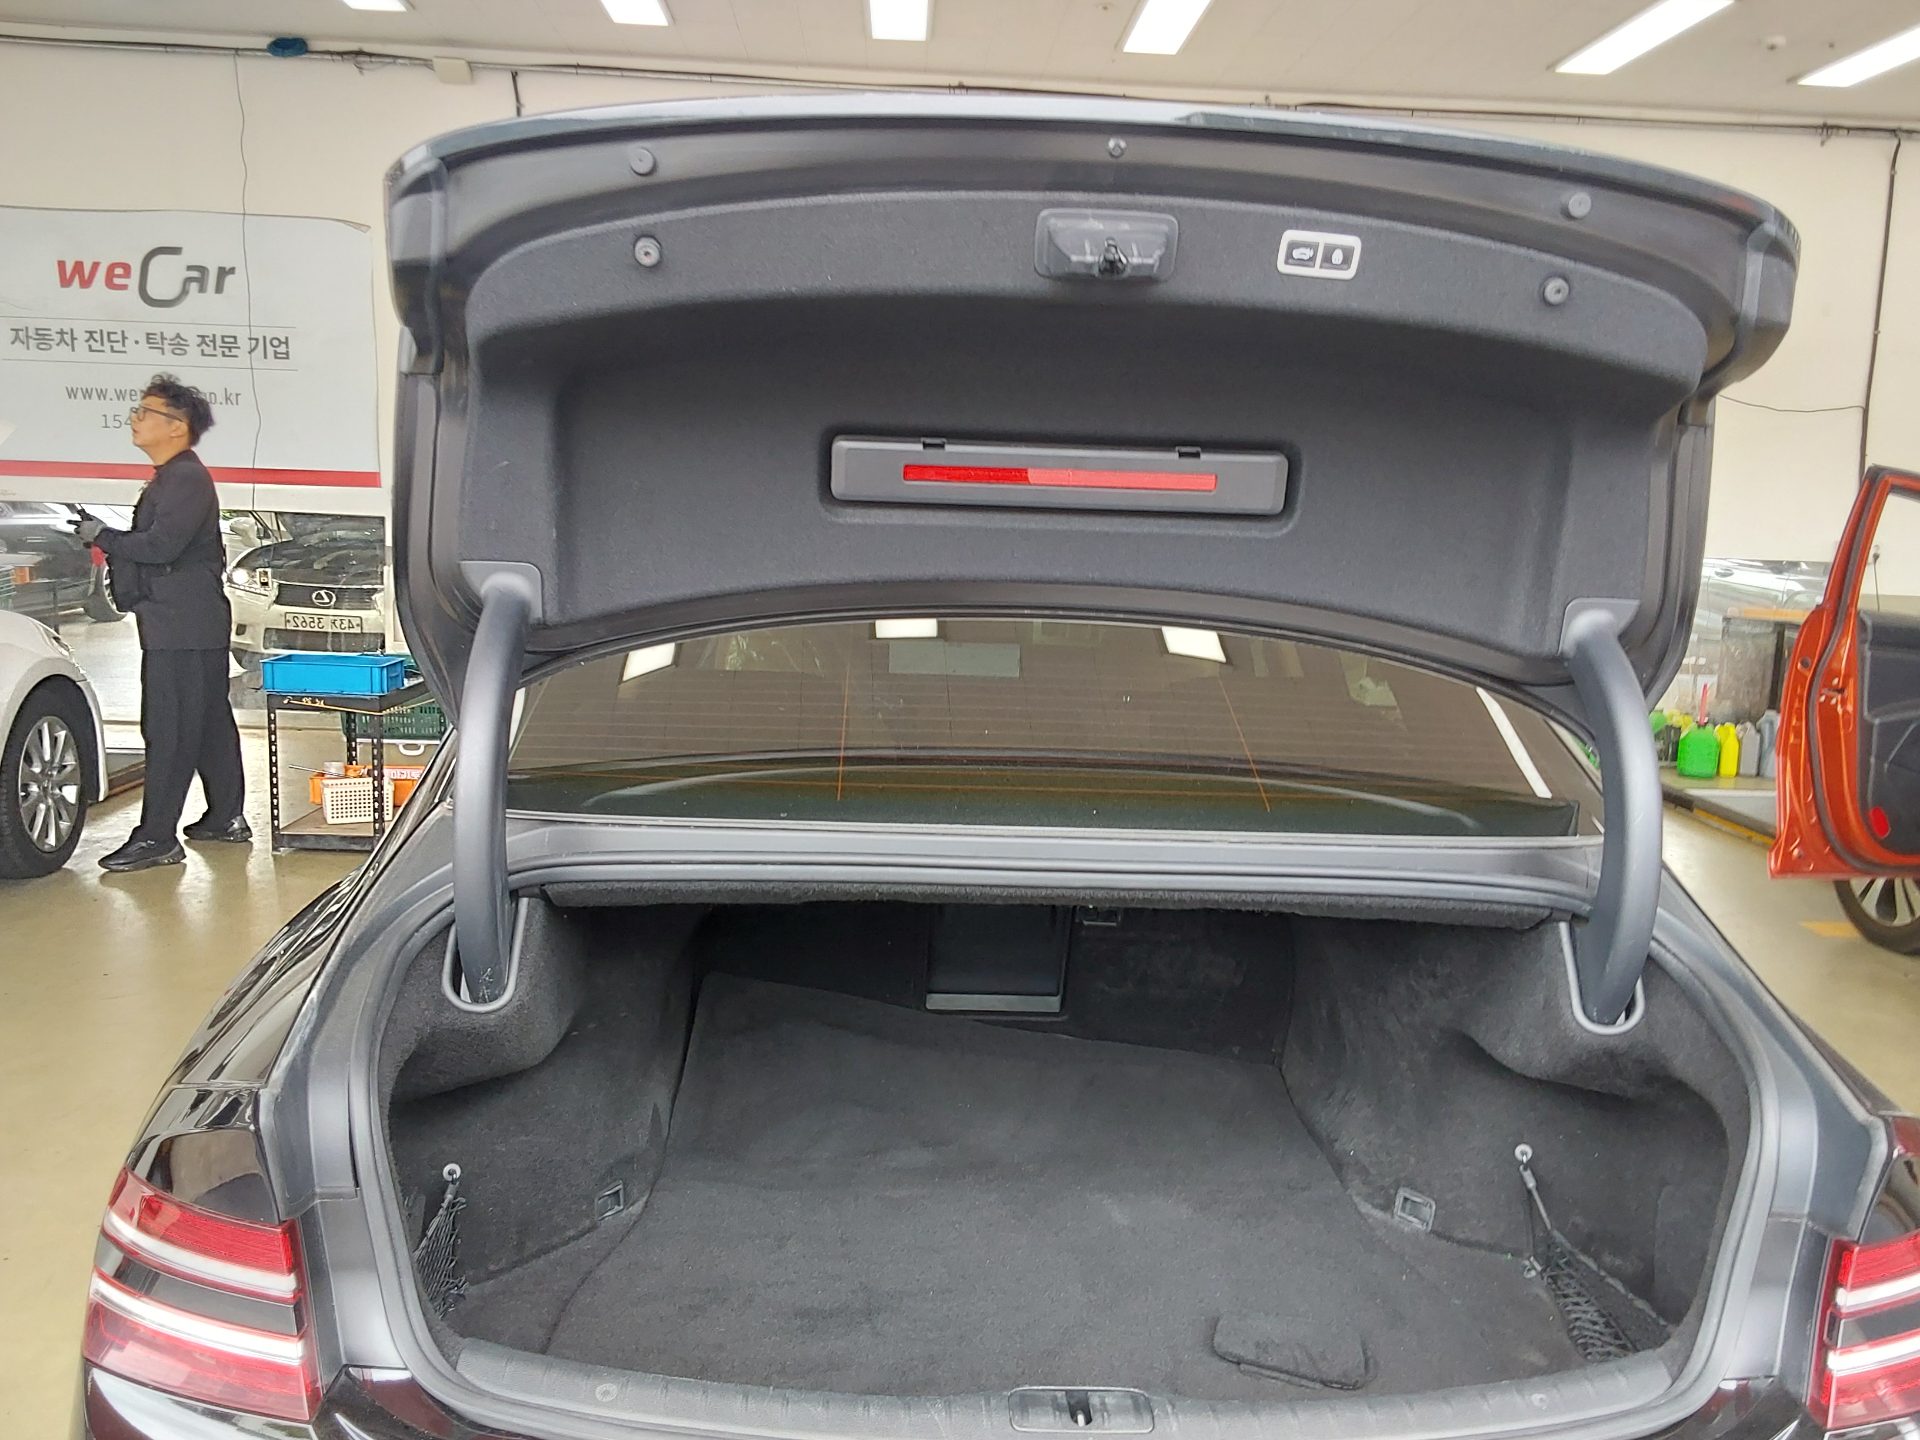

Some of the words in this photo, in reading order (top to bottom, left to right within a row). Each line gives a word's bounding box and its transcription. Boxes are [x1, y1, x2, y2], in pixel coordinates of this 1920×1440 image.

[56, 246, 236, 309] weCar
[10, 326, 77, 352] 자동차
[196, 333, 241, 358] 전문
[248, 335, 291, 360] 기업
